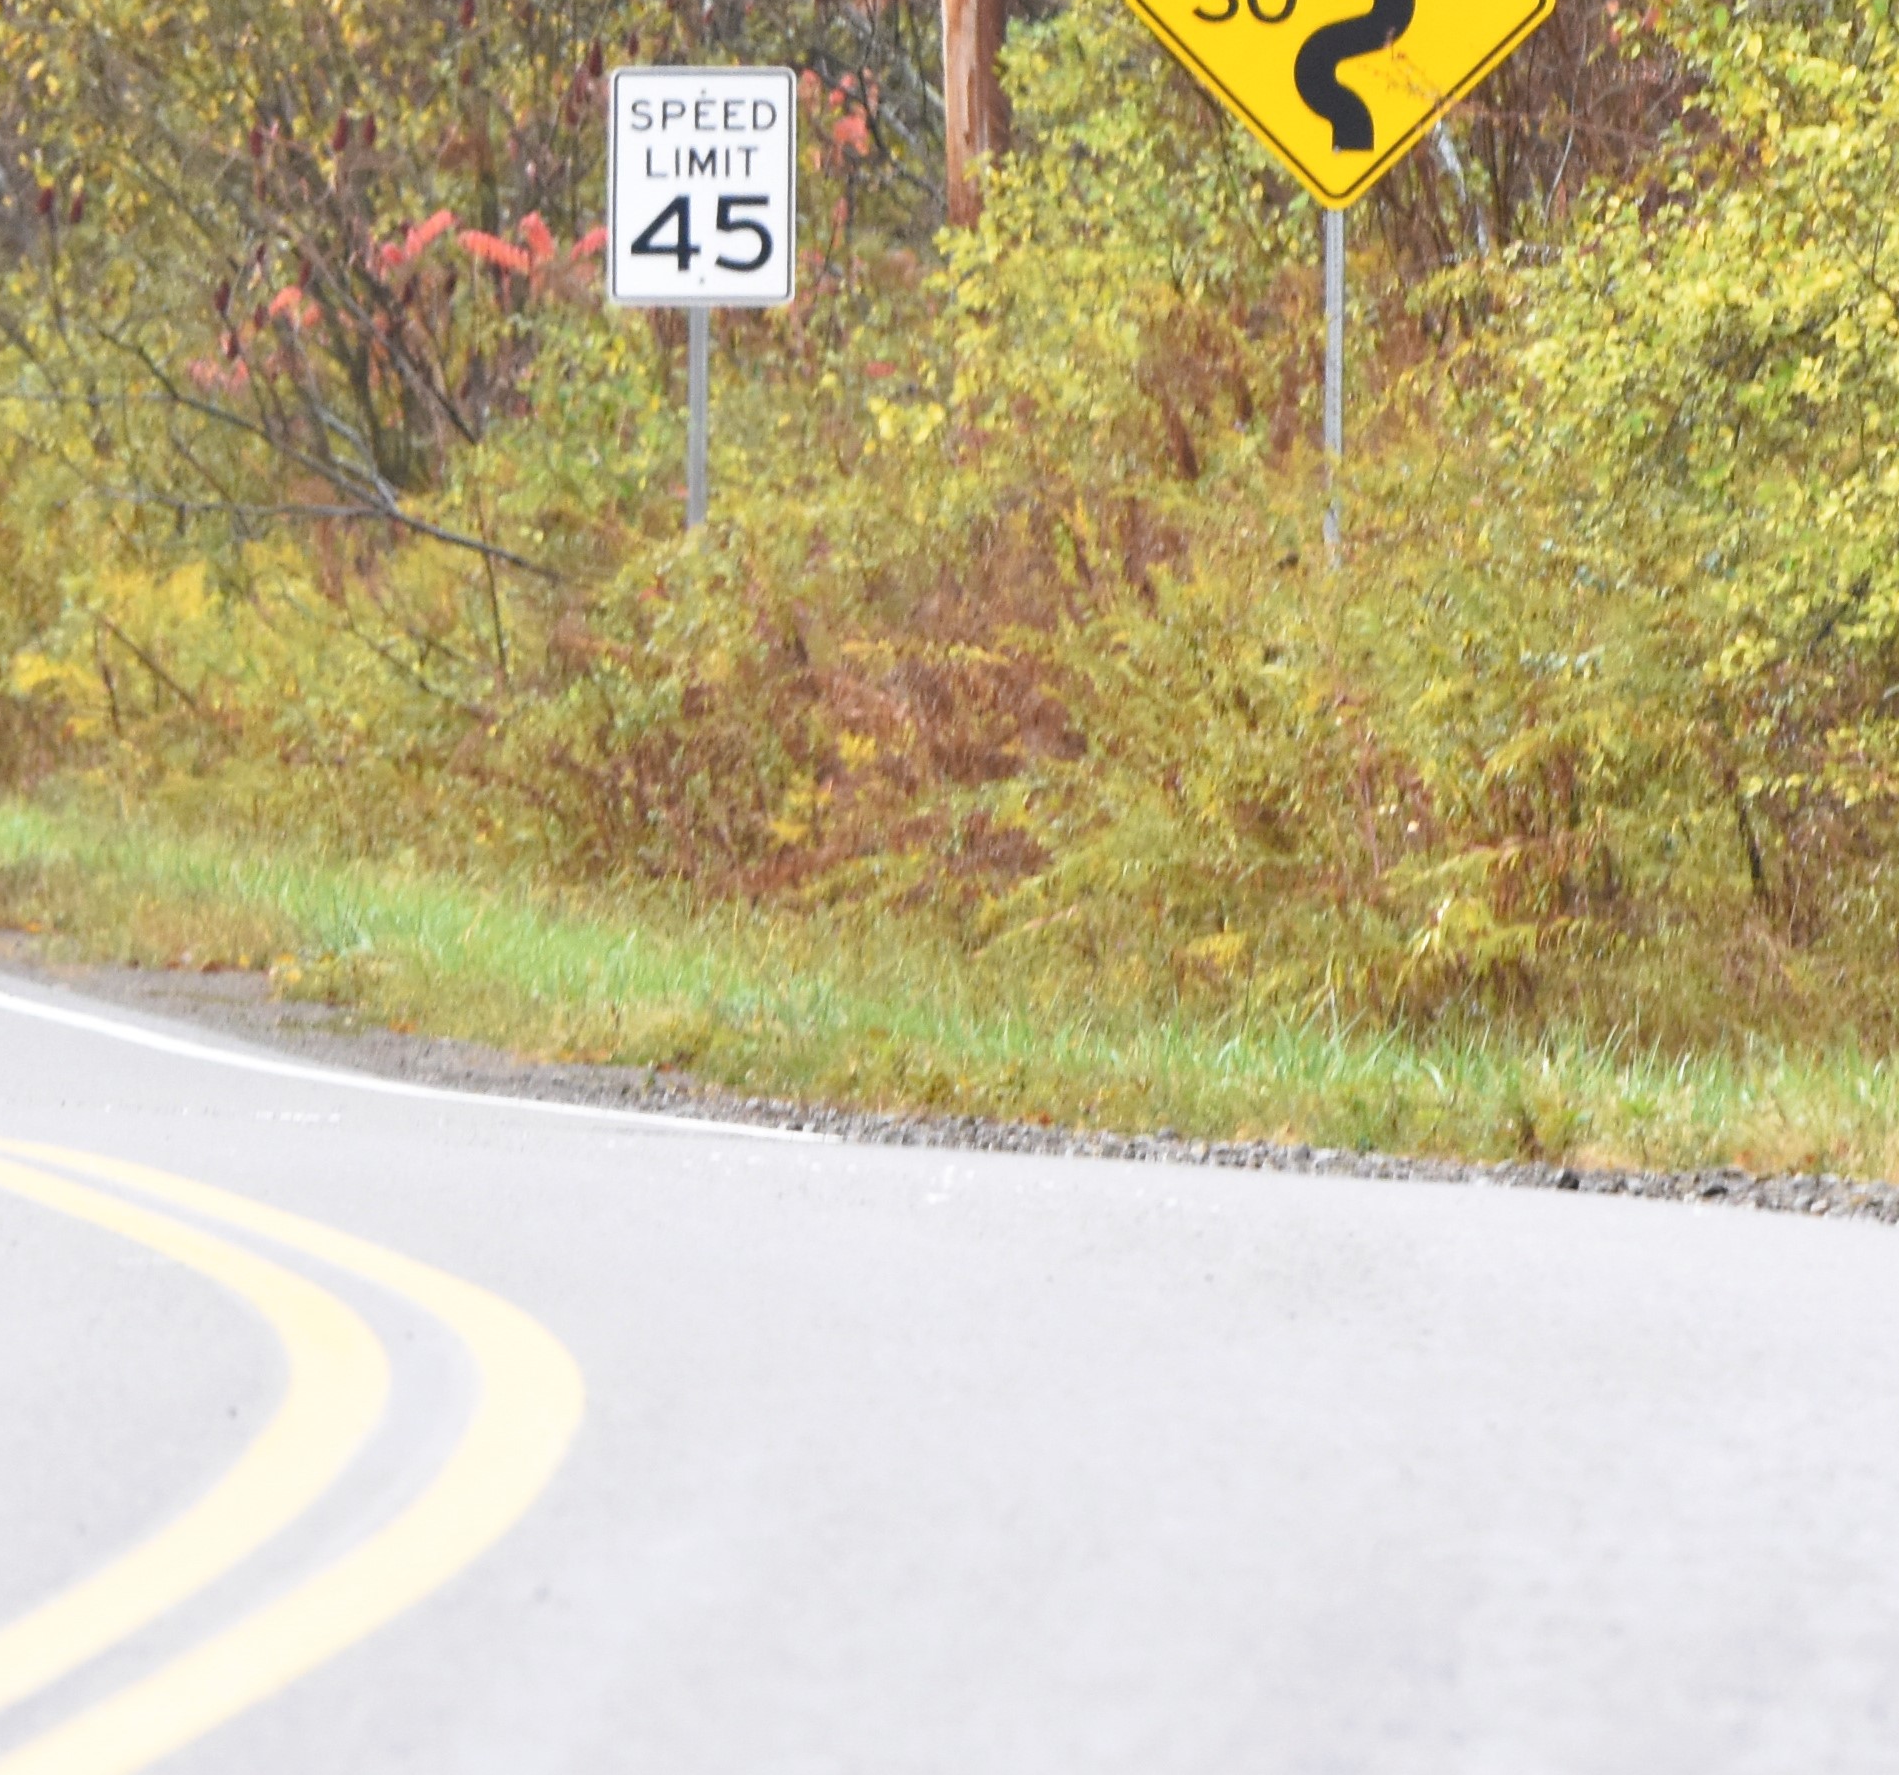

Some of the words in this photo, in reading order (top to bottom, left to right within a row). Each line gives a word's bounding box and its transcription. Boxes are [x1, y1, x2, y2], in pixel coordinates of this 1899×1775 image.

[631, 99, 778, 131] SPEED
[645, 147, 758, 178] LIMIT
[630, 194, 774, 273] 45
